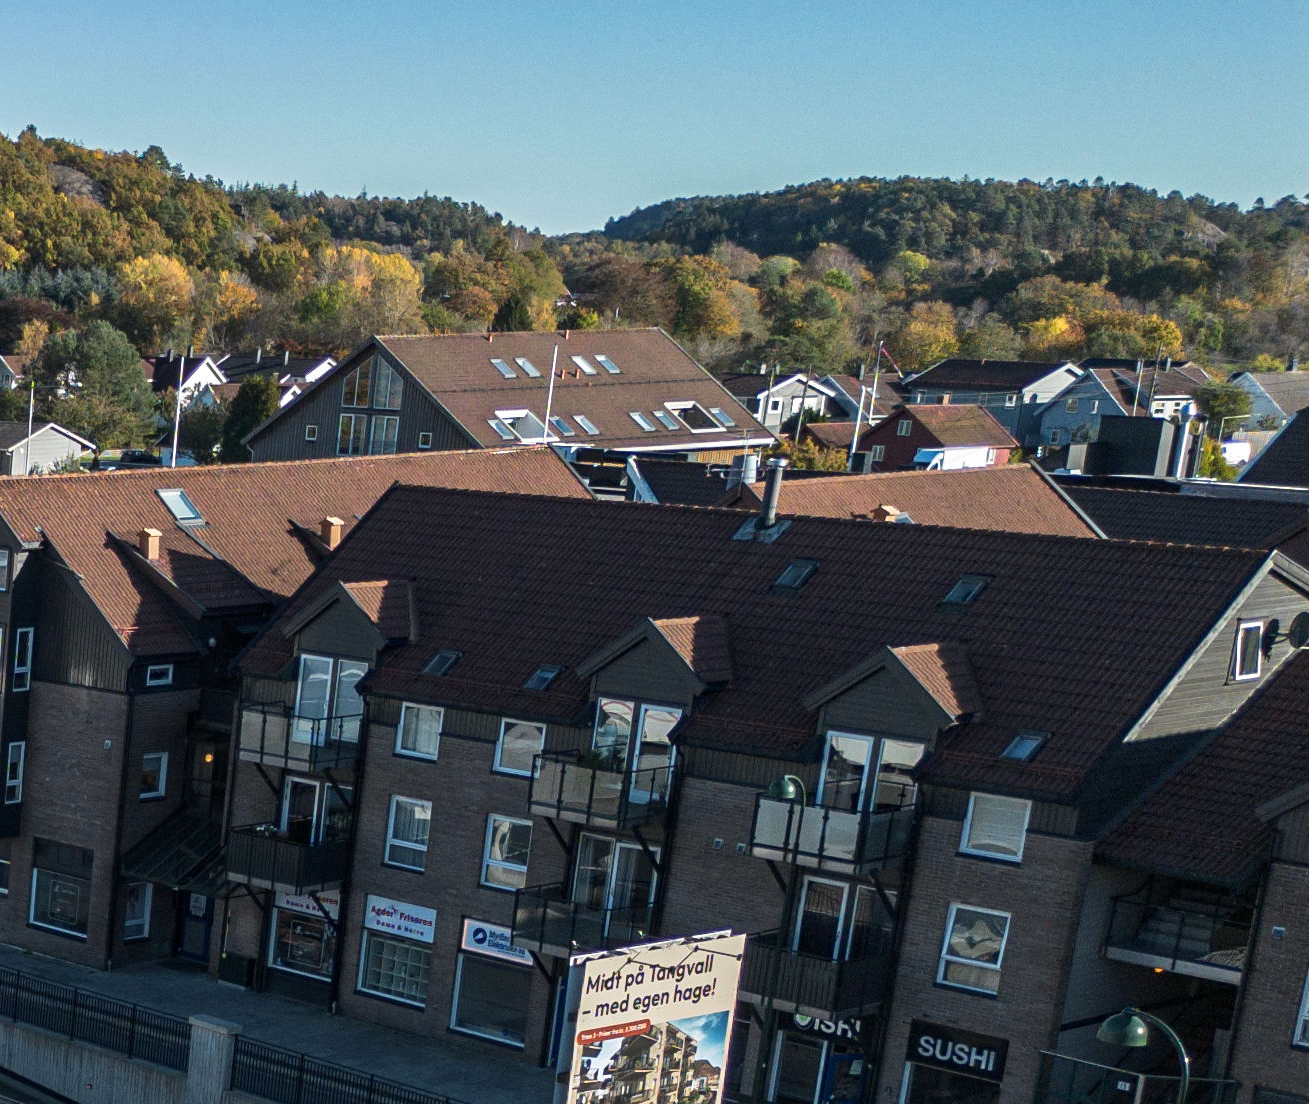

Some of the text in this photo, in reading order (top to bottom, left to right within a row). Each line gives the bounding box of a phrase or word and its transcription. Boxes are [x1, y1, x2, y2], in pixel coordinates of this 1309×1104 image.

[586, 954, 714, 995] Midt på Tangvall
[595, 993, 630, 1018] med
[633, 989, 670, 1014] egen
[674, 977, 717, 1004] hage!
[917, 1035, 996, 1072] SUSHI
